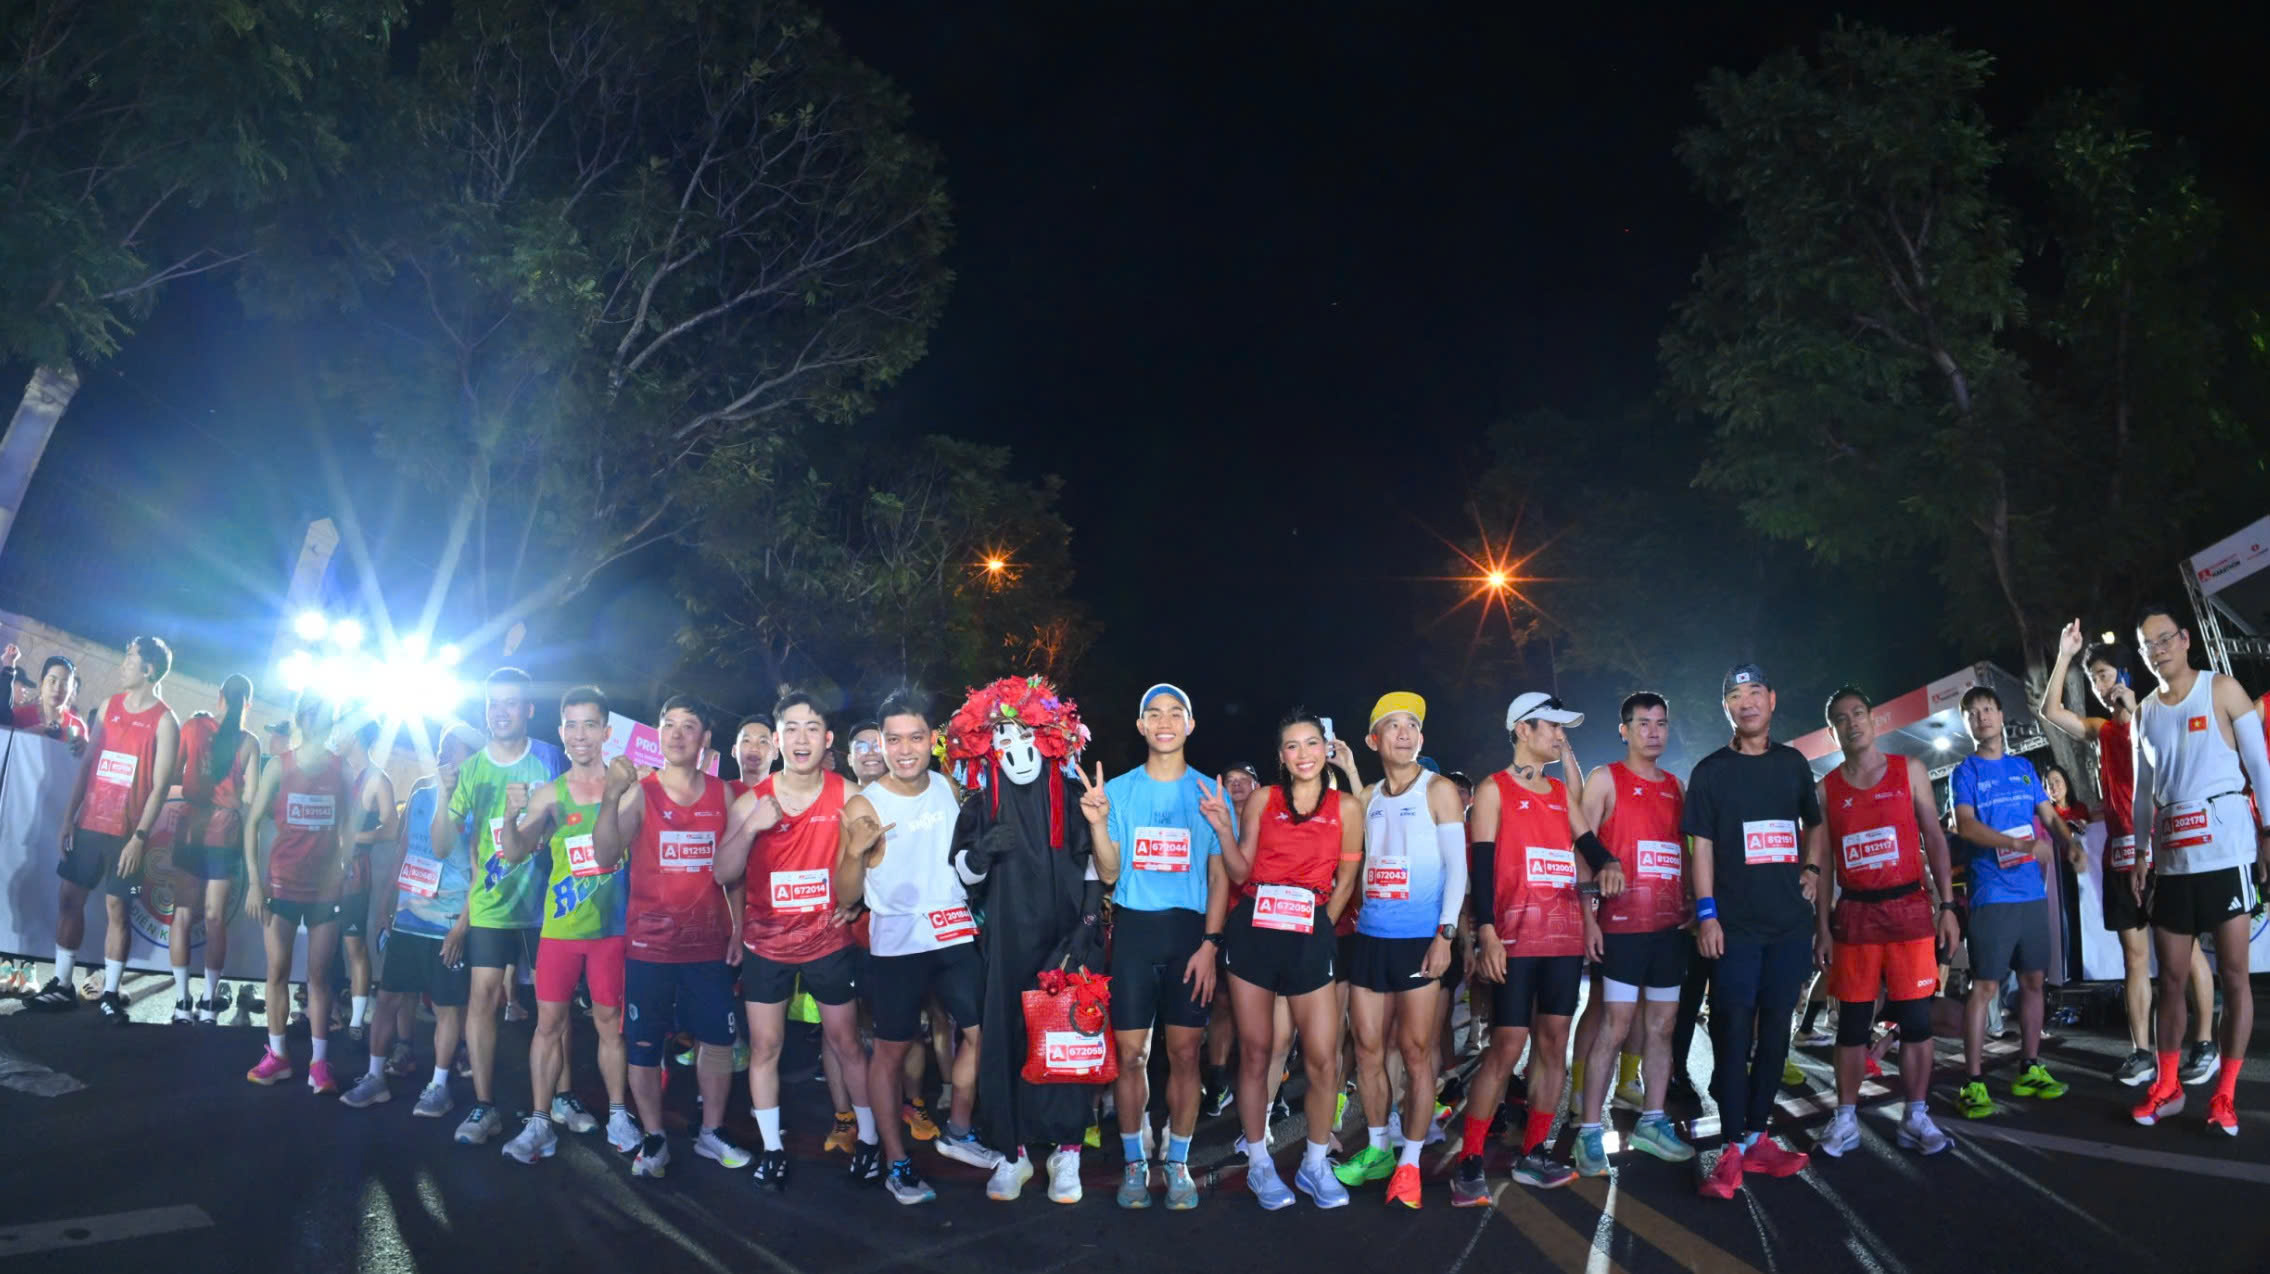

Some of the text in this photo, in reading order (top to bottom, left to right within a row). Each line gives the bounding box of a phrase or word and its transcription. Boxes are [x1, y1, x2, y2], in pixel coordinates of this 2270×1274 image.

[635, 736, 658, 753] PRO
[1136, 841, 1148, 854] A
[1751, 835, 1762, 848] A
[573, 852, 584, 864] A
[665, 845, 677, 858] A
[1849, 847, 1860, 860] A
[1642, 853, 1654, 865] A
[1532, 861, 1543, 874] A
[777, 886, 789, 899] A
[1260, 898, 1272, 912] A
[932, 913, 945, 926] C
[1052, 1046, 1065, 1059] A
